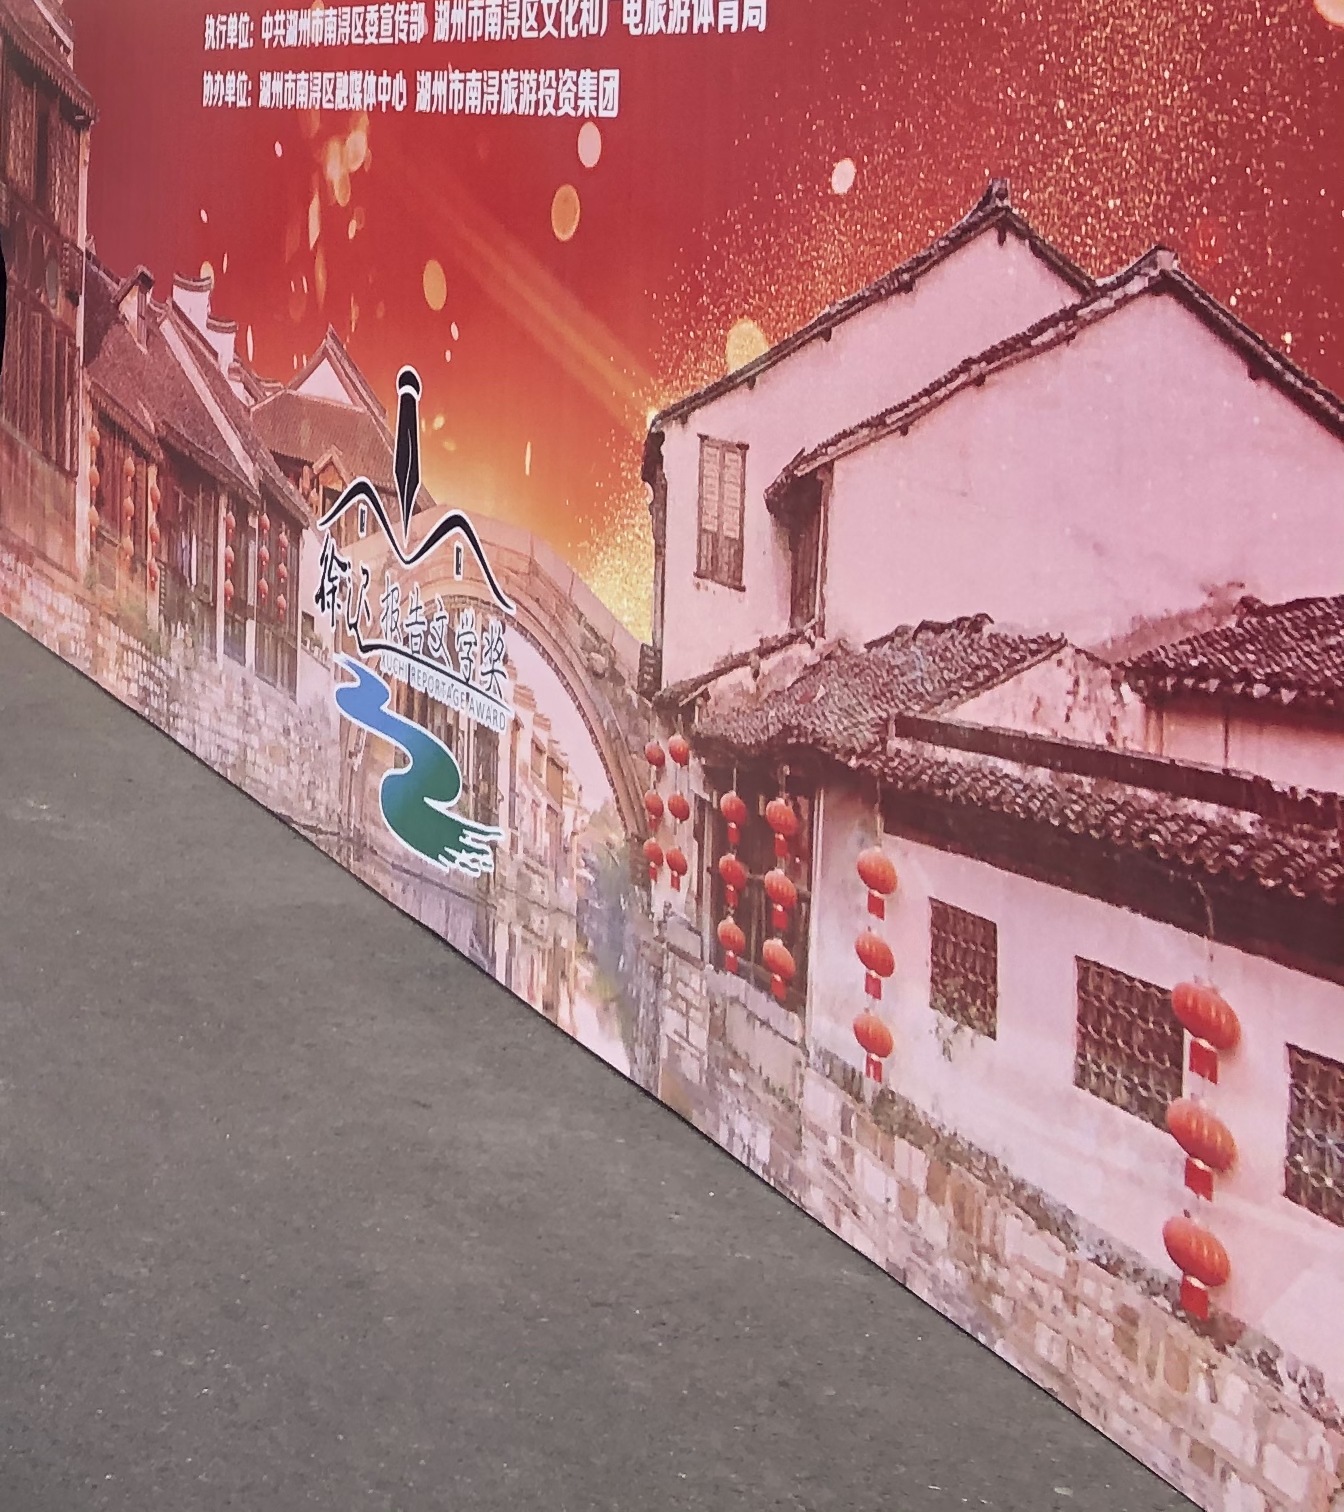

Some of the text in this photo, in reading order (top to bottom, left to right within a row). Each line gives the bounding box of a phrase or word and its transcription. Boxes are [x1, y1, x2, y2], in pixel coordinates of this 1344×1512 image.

[415, 67, 620, 119] 湖州市南浔旅游投资集团
[468, 696, 506, 732] AWARD
